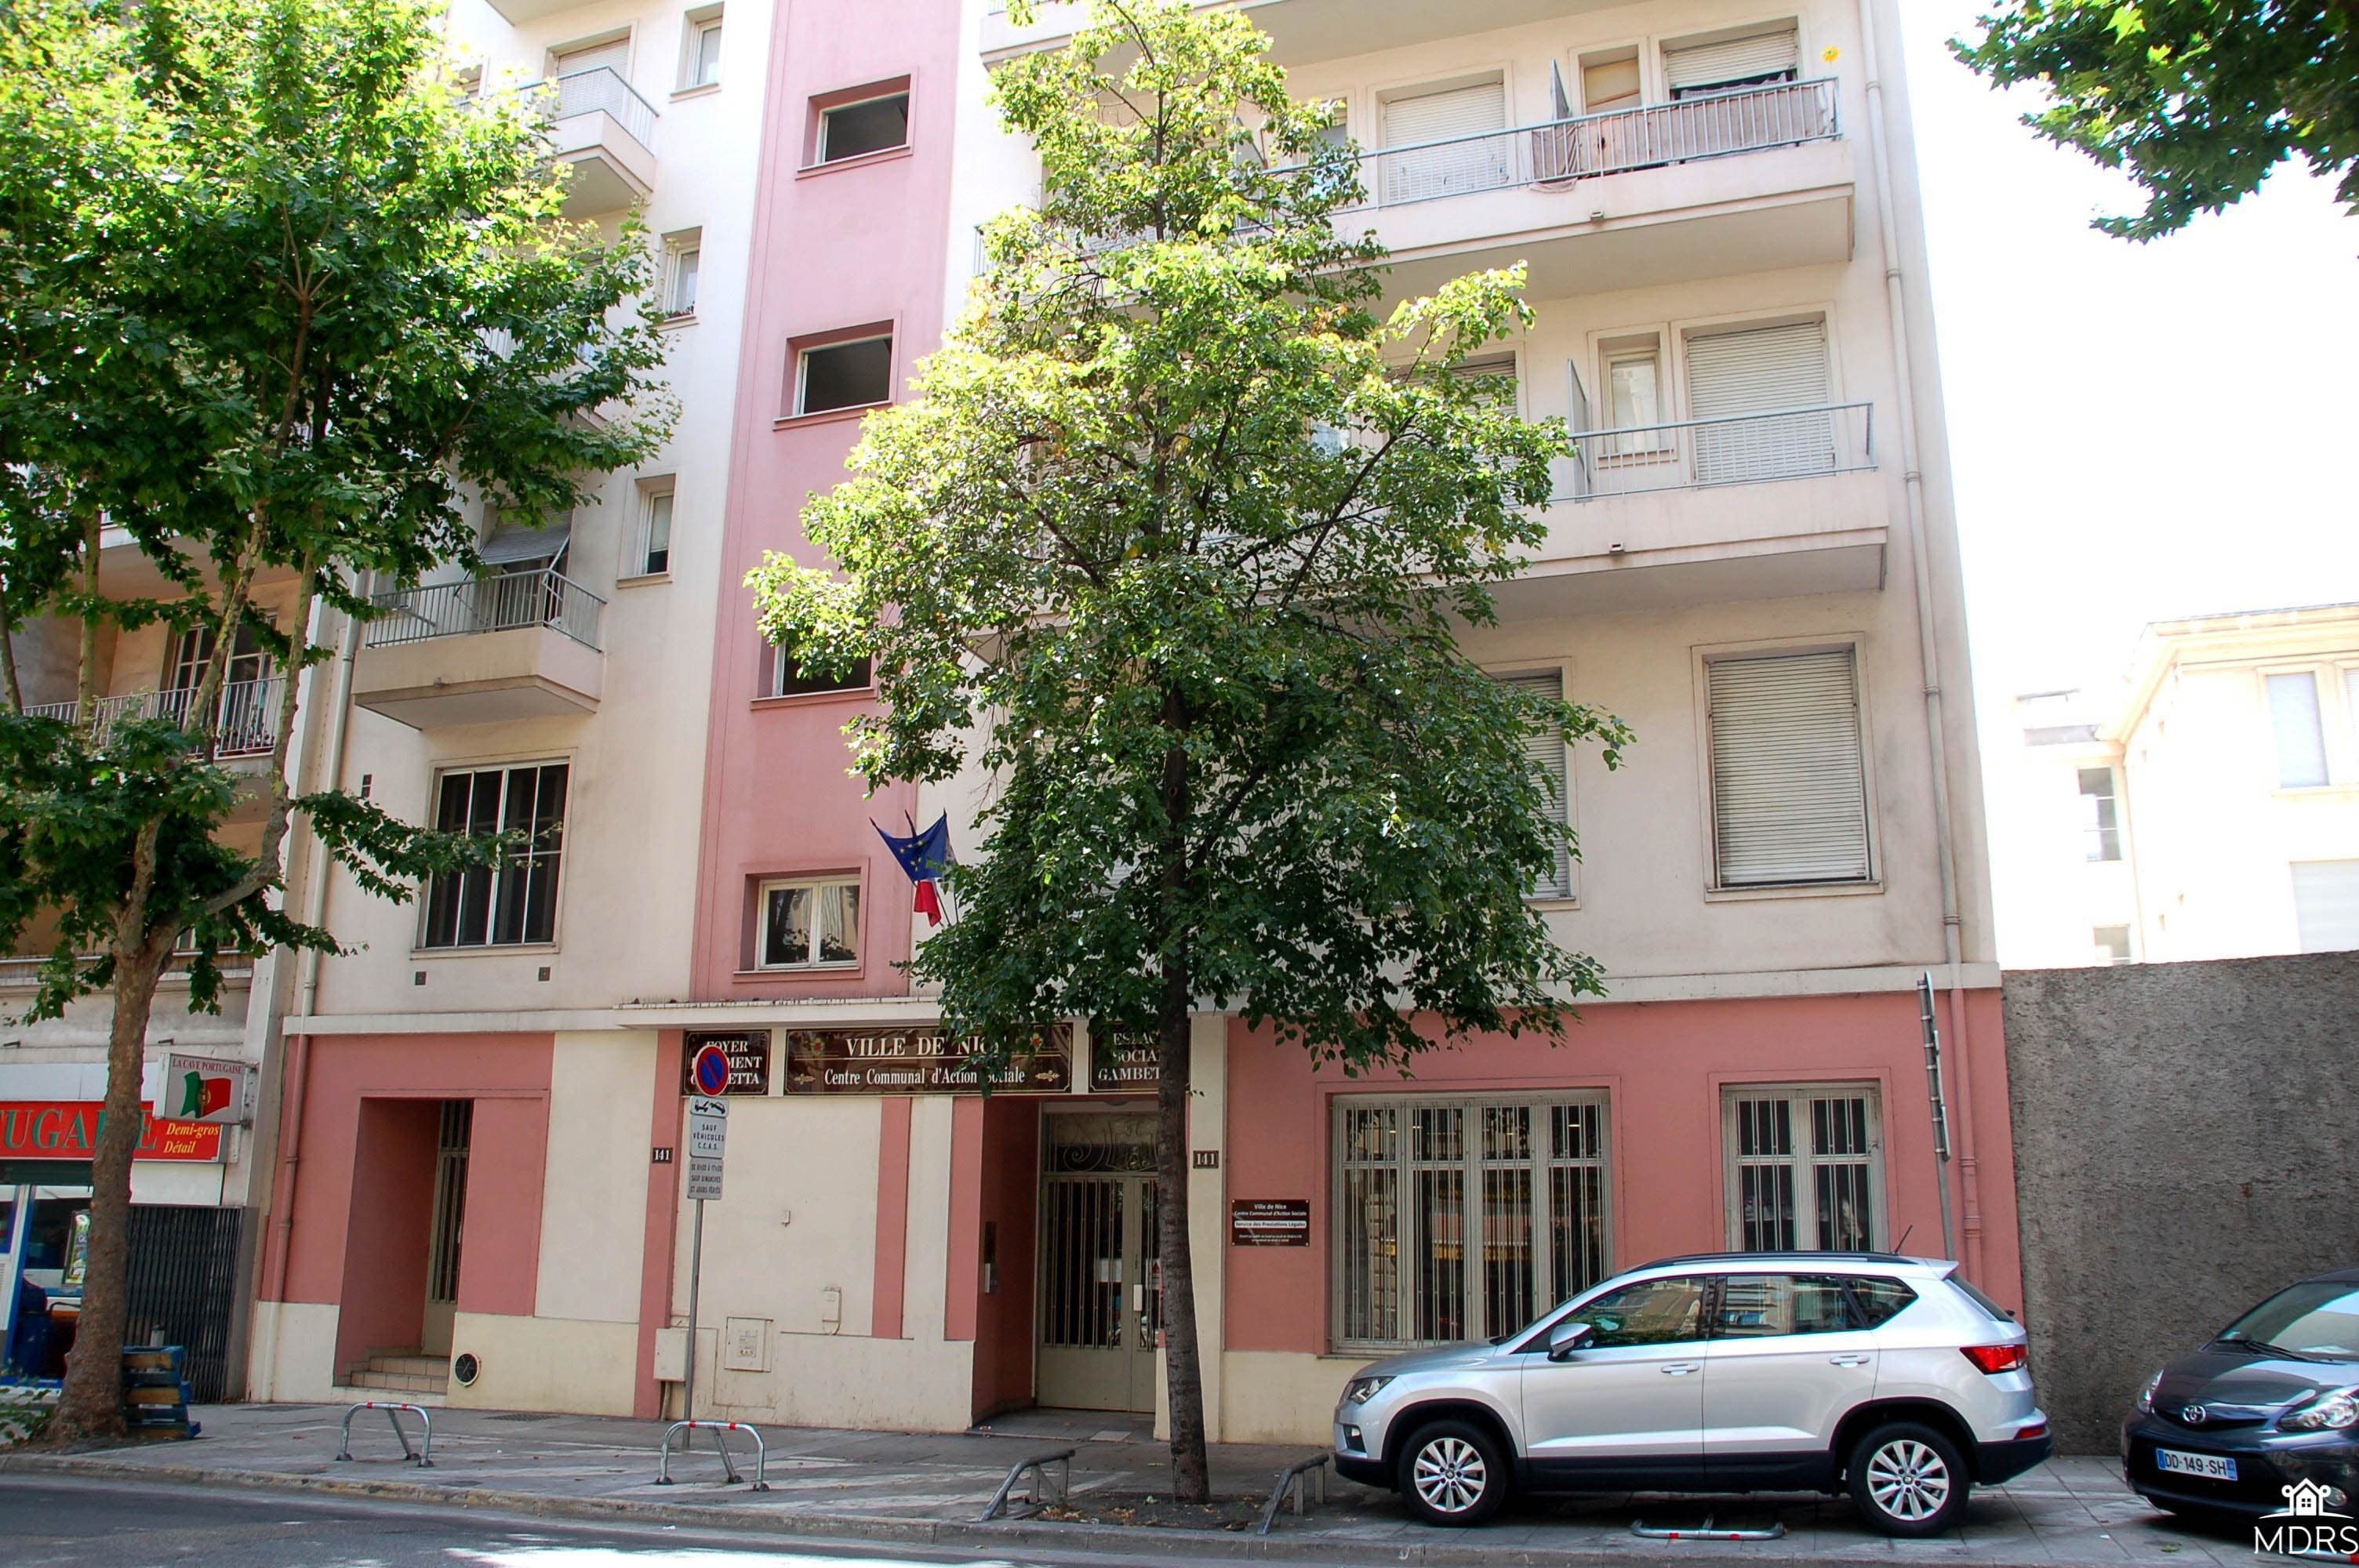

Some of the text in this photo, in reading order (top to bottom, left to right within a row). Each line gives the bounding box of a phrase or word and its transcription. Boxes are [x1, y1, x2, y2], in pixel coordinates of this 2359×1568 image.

[845, 1036, 906, 1057] VILLE
[917, 1036, 945, 1055] DE
[1112, 1049, 1161, 1062] SOCIA
[183, 1059, 201, 1070] CAVE
[202, 1062, 243, 1074] PORTUGAISE
[824, 1068, 860, 1085] Centre
[867, 1068, 925, 1085] Communal
[931, 1066, 977, 1084] d'Action
[166, 1122, 219, 1139] Demi-gros
[163, 1141, 196, 1154] Détail
[655, 1149, 670, 1160] 141
[1196, 1153, 1216, 1166] 141
[2165, 1453, 2227, 1475] DD-149-SH
